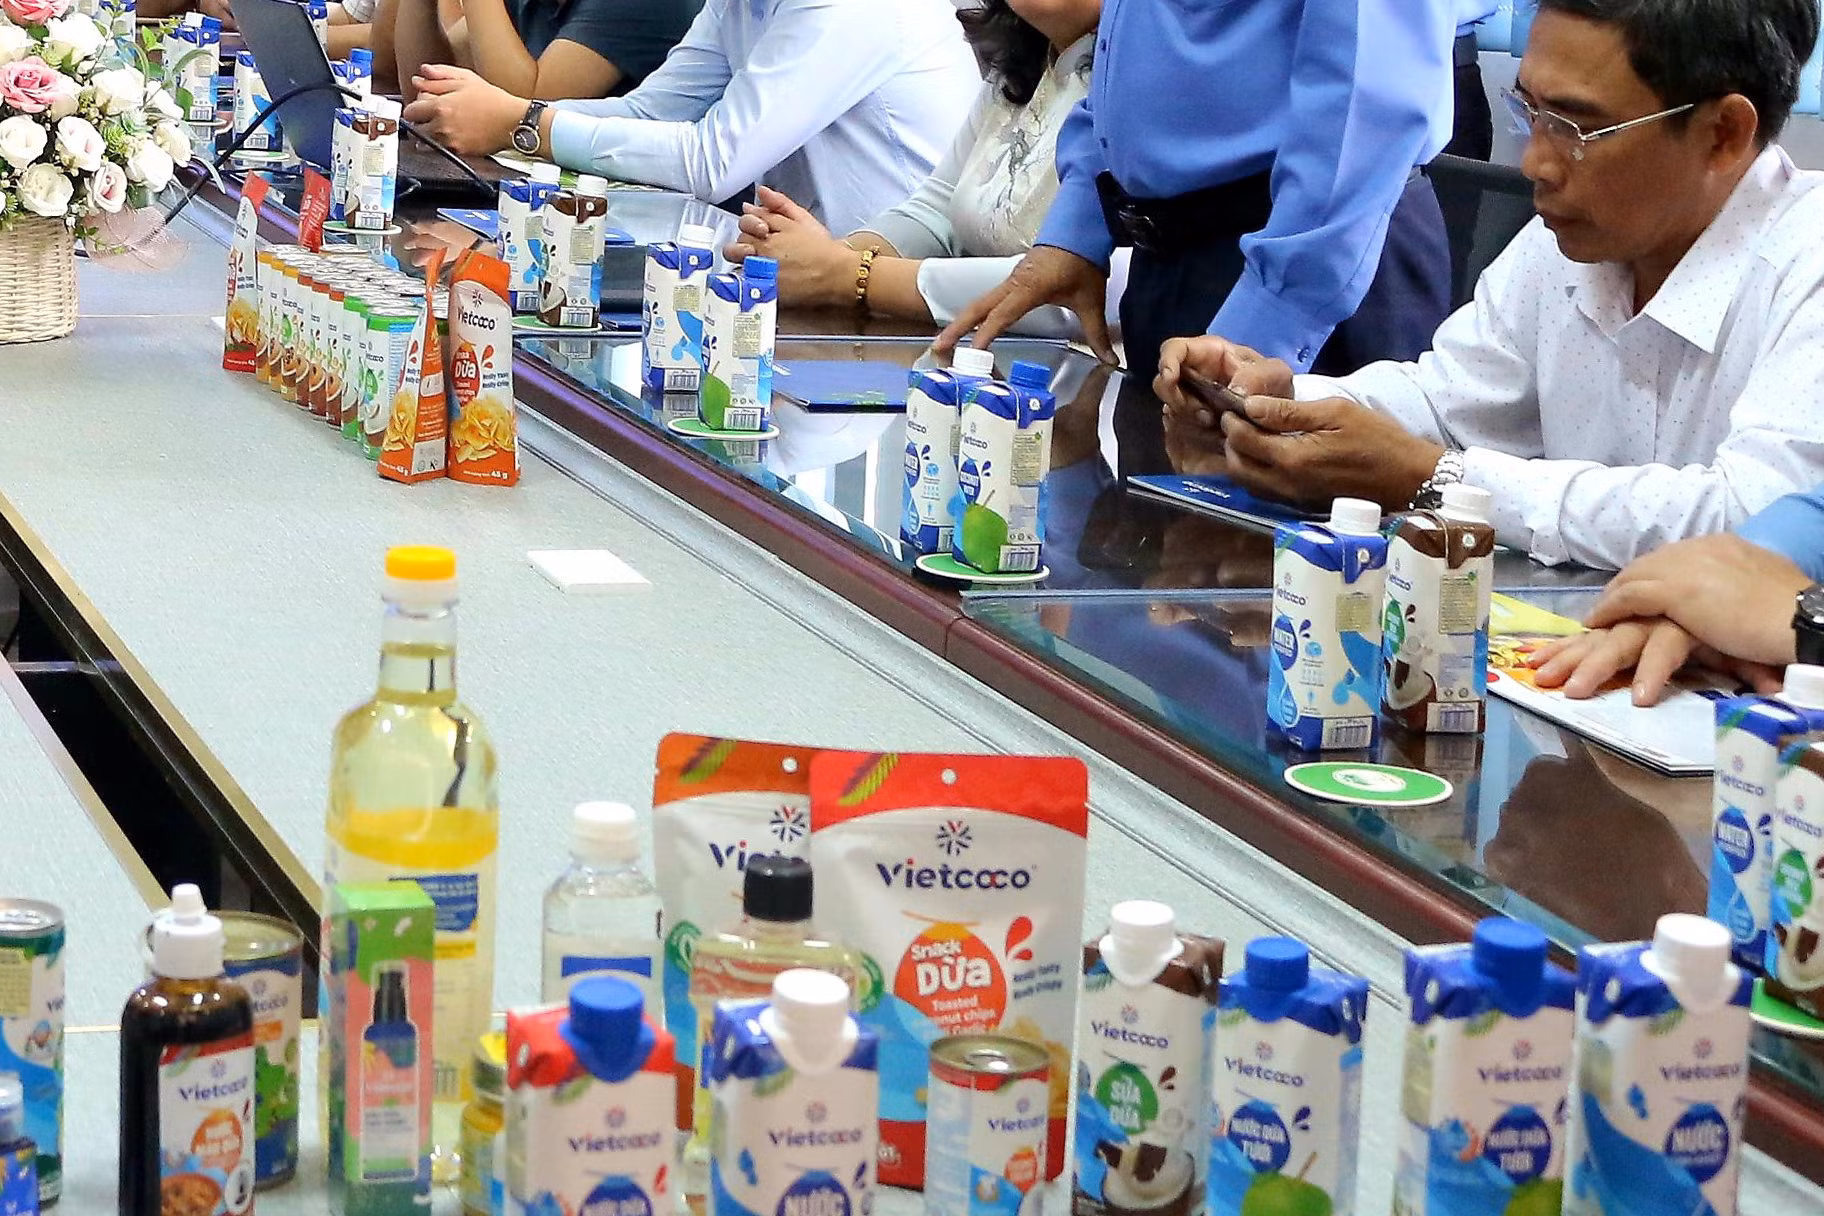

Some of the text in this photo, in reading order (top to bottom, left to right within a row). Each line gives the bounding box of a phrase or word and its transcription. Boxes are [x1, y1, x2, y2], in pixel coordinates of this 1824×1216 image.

[877, 857, 1030, 889] Vietcoco
[911, 938, 962, 962] Snack
[1091, 1020, 1169, 1049] Vietcoco
[1225, 1055, 1304, 1087] Vietcoco
[1478, 1062, 1563, 1082] Vietcoco
[1660, 1063, 1740, 1082] Vietcoco
[569, 1130, 661, 1153] Vietcoco
[769, 1125, 863, 1147] Vietcoco
